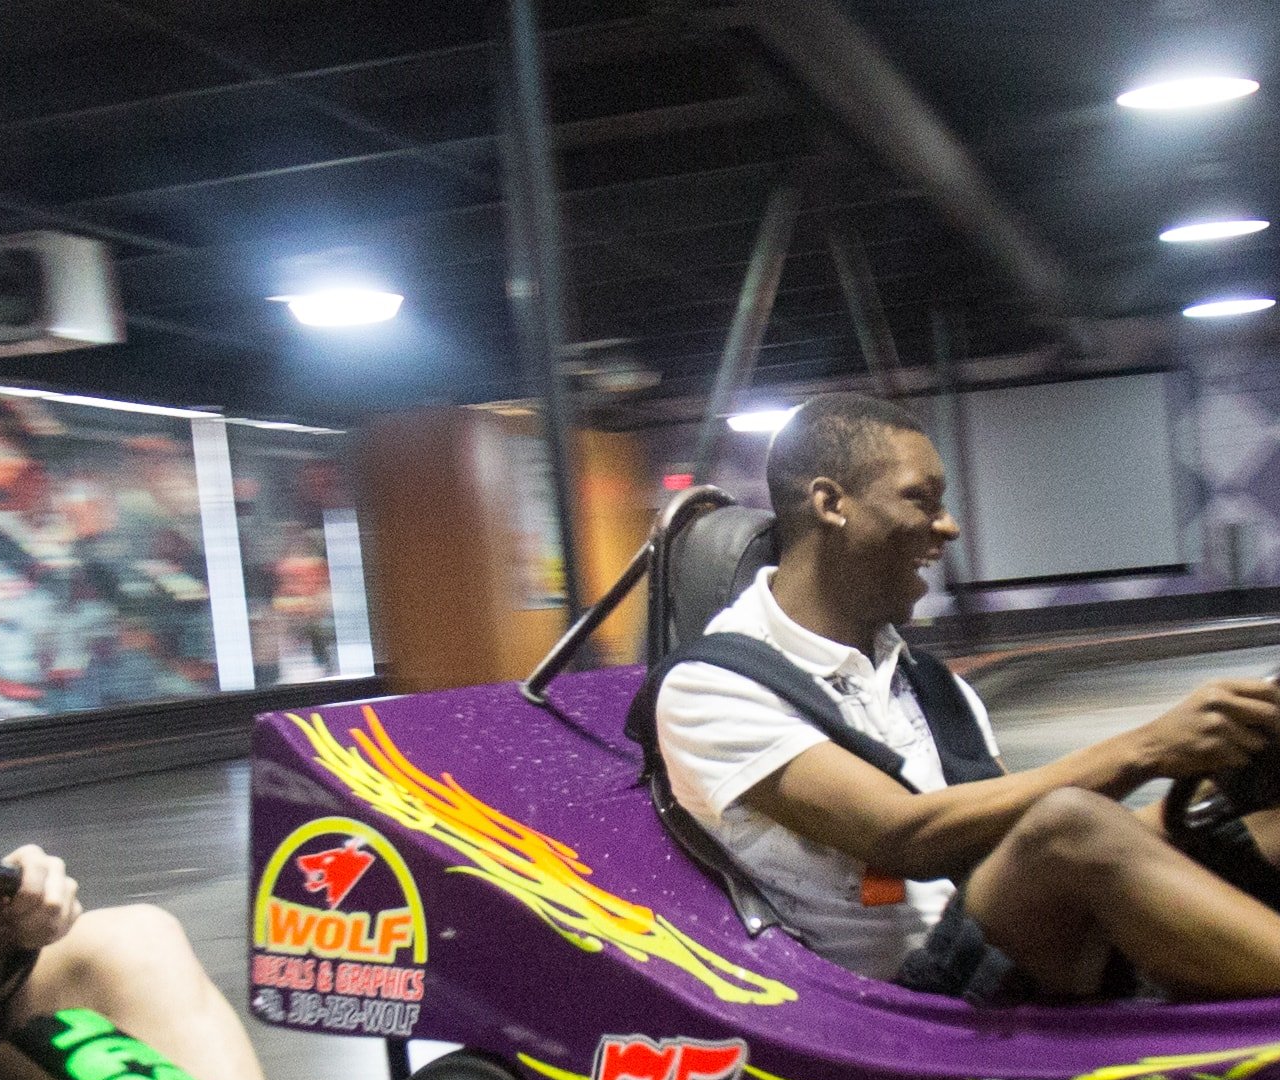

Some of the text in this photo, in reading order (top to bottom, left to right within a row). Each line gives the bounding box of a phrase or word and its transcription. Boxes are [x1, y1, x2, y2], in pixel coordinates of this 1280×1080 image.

[269, 900, 413, 959] WOLF
[316, 959, 334, 993] &
[335, 962, 426, 1002] GRAPHICS
